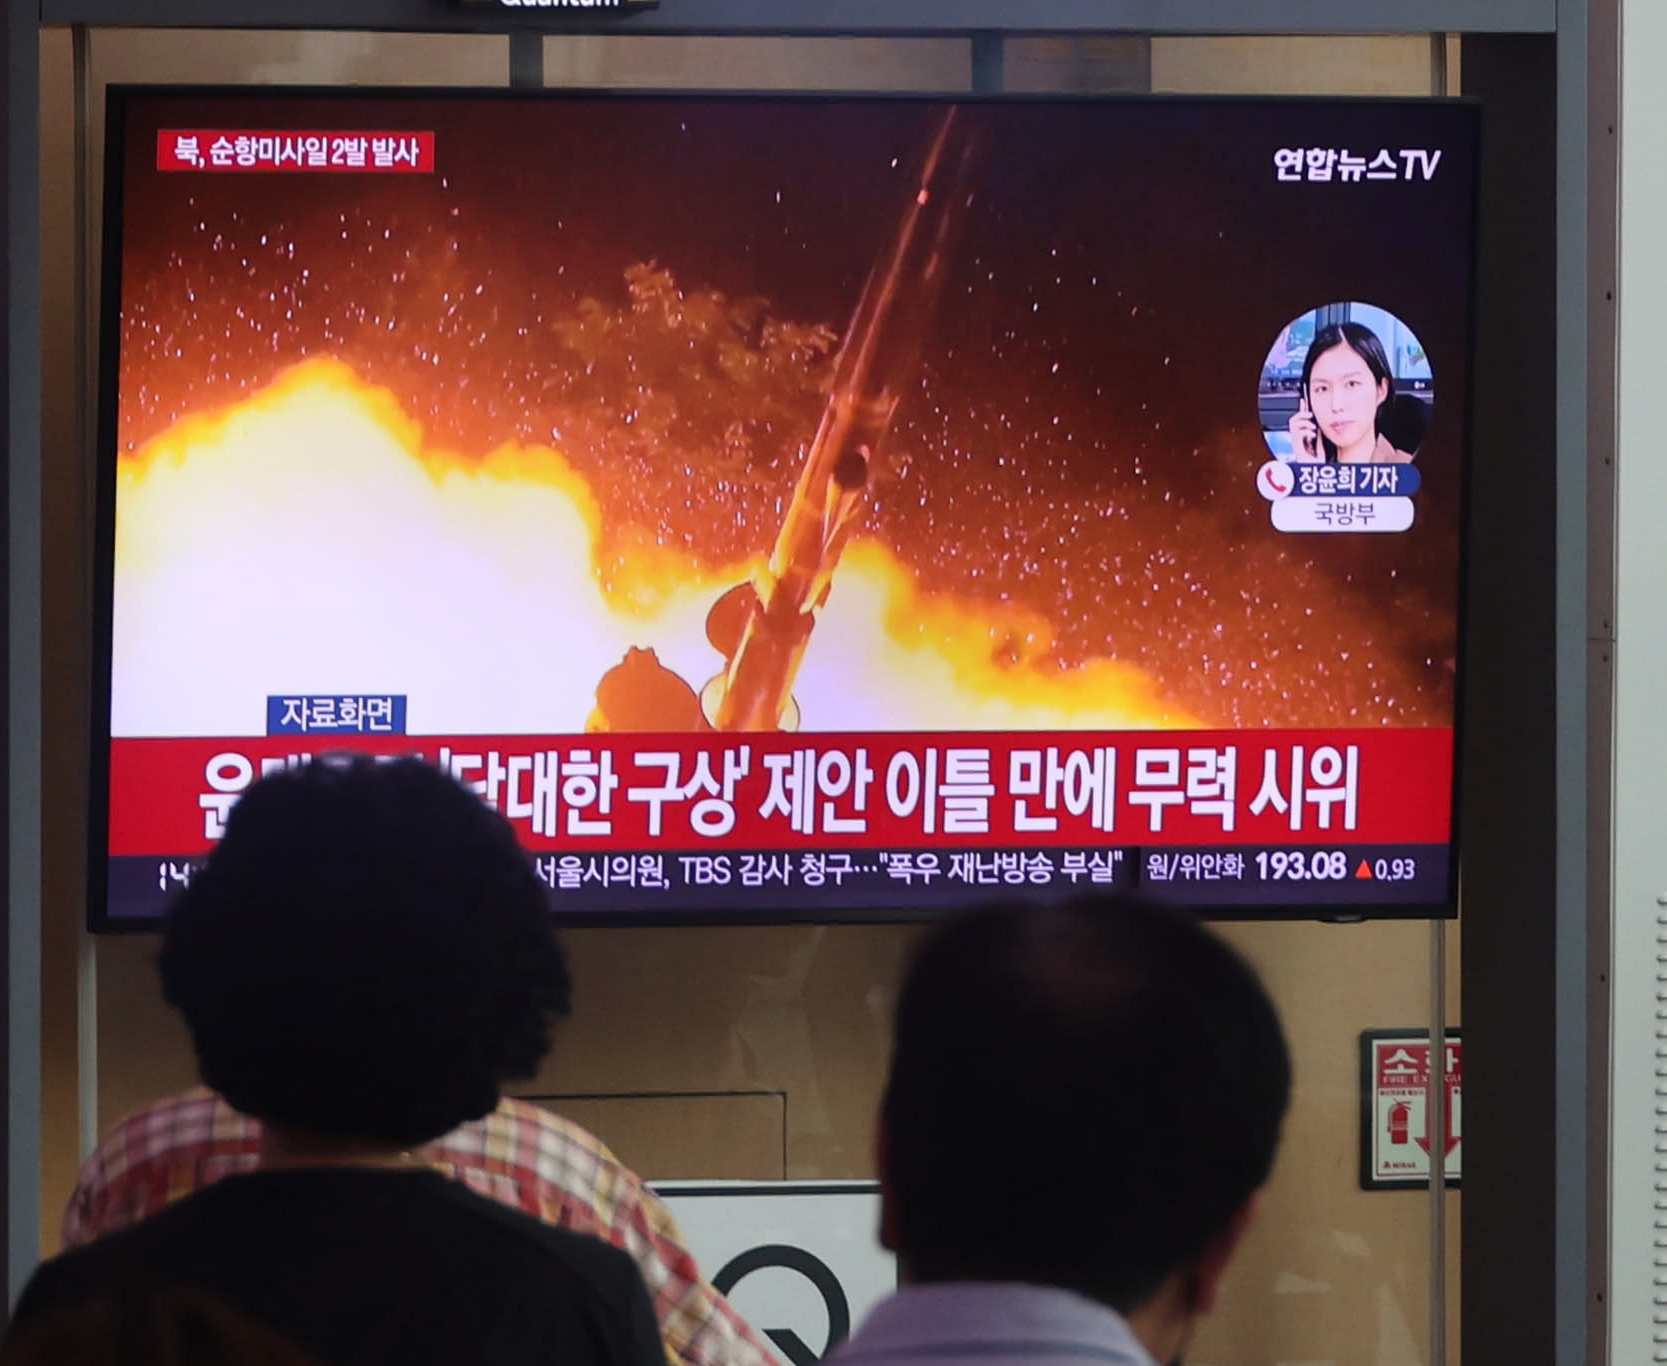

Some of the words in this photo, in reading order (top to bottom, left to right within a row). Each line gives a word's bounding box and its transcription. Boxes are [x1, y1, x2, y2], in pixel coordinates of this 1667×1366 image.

[175, 136, 205, 168] 북,
[210, 136, 328, 167] 순항미사일
[332, 137, 368, 167] 2발
[372, 137, 419, 167] 발사
[1273, 147, 1442, 182] 연합뉴스TV
[1299, 466, 1356, 494] 장윤희
[1360, 466, 1398, 494] 기자
[1314, 502, 1375, 526] 국방부
[280, 697, 394, 734] 자료화면
[627, 744, 752, 838] 구상'
[759, 747, 874, 835] 제안
[885, 747, 996, 835] 이틀
[1007, 745, 1117, 834] 만에
[1128, 745, 1238, 833] 무력
[1248, 744, 1359, 831] 시위
[678, 855, 731, 884] TBS
[738, 854, 793, 887] 감사
[948, 851, 1055, 884] 재난방송
[1060, 850, 1123, 883] 부실"
[1147, 853, 1245, 880] 원/위안화
[1255, 851, 1347, 880] 193.08
[1374, 858, 1415, 881] 0.93
